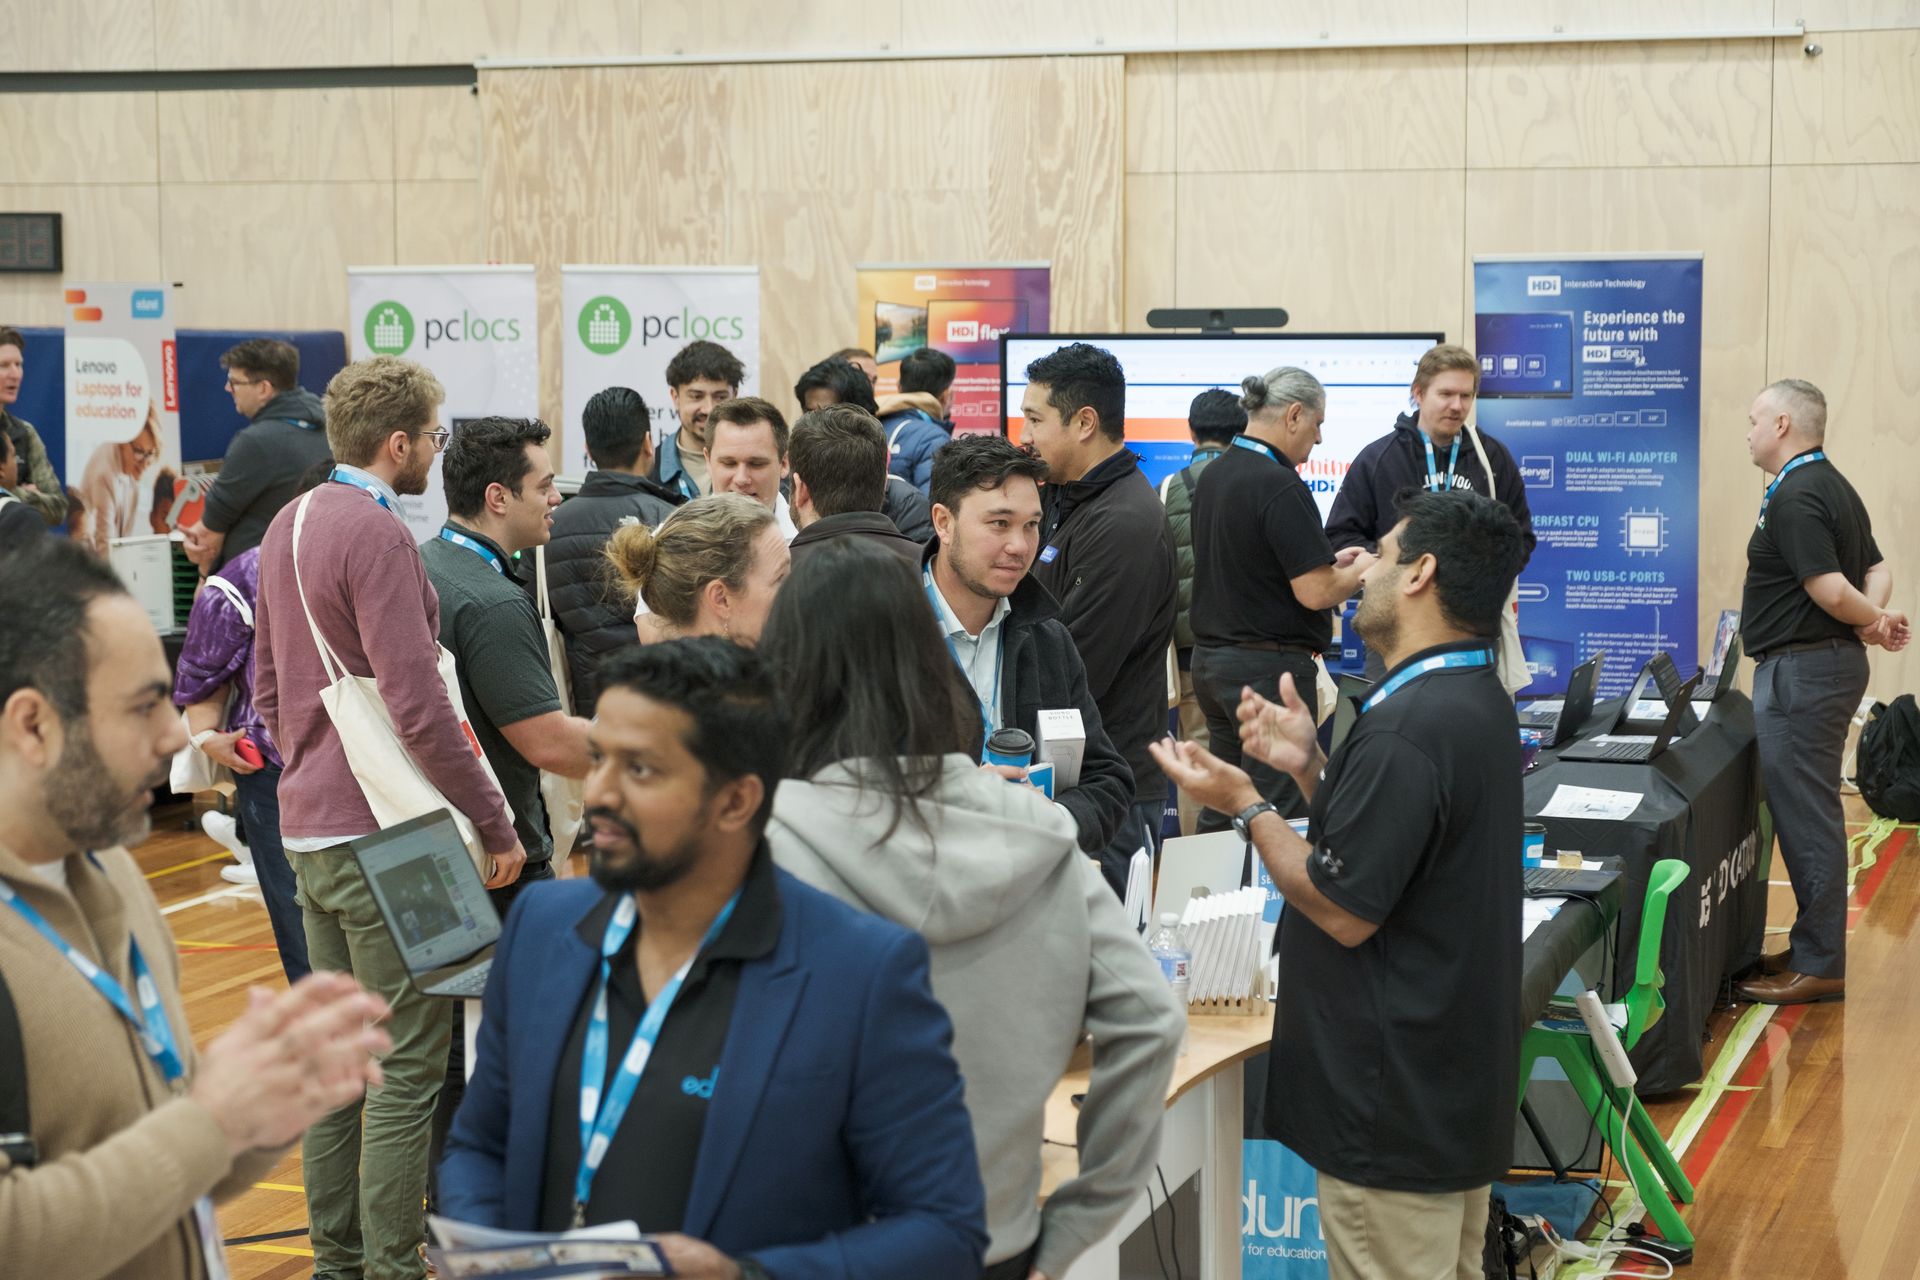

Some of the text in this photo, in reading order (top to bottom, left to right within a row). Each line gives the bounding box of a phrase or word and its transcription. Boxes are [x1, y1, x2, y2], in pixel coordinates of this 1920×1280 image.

[1532, 278, 1646, 291] HDi Interactive Technology
[1583, 310, 1685, 326] Experience the
[424, 309, 521, 349] pclocs
[643, 306, 743, 346] pclocs
[951, 326, 975, 338] HDi
[1583, 329, 1659, 342] future with
[1586, 349, 1607, 359] HDi
[1612, 348, 1640, 362] edge
[75, 358, 117, 374] Lenovo
[76, 380, 142, 399] Laptops for
[76, 403, 137, 419] education
[1566, 451, 1678, 464] DUAL WI-FI ADAPTER
[1305, 480, 1334, 492] HDi
[1577, 515, 1599, 527] CPU
[1566, 571, 1665, 583] TWO USB-C PORTS
[1248, 1243, 1326, 1260] for education
